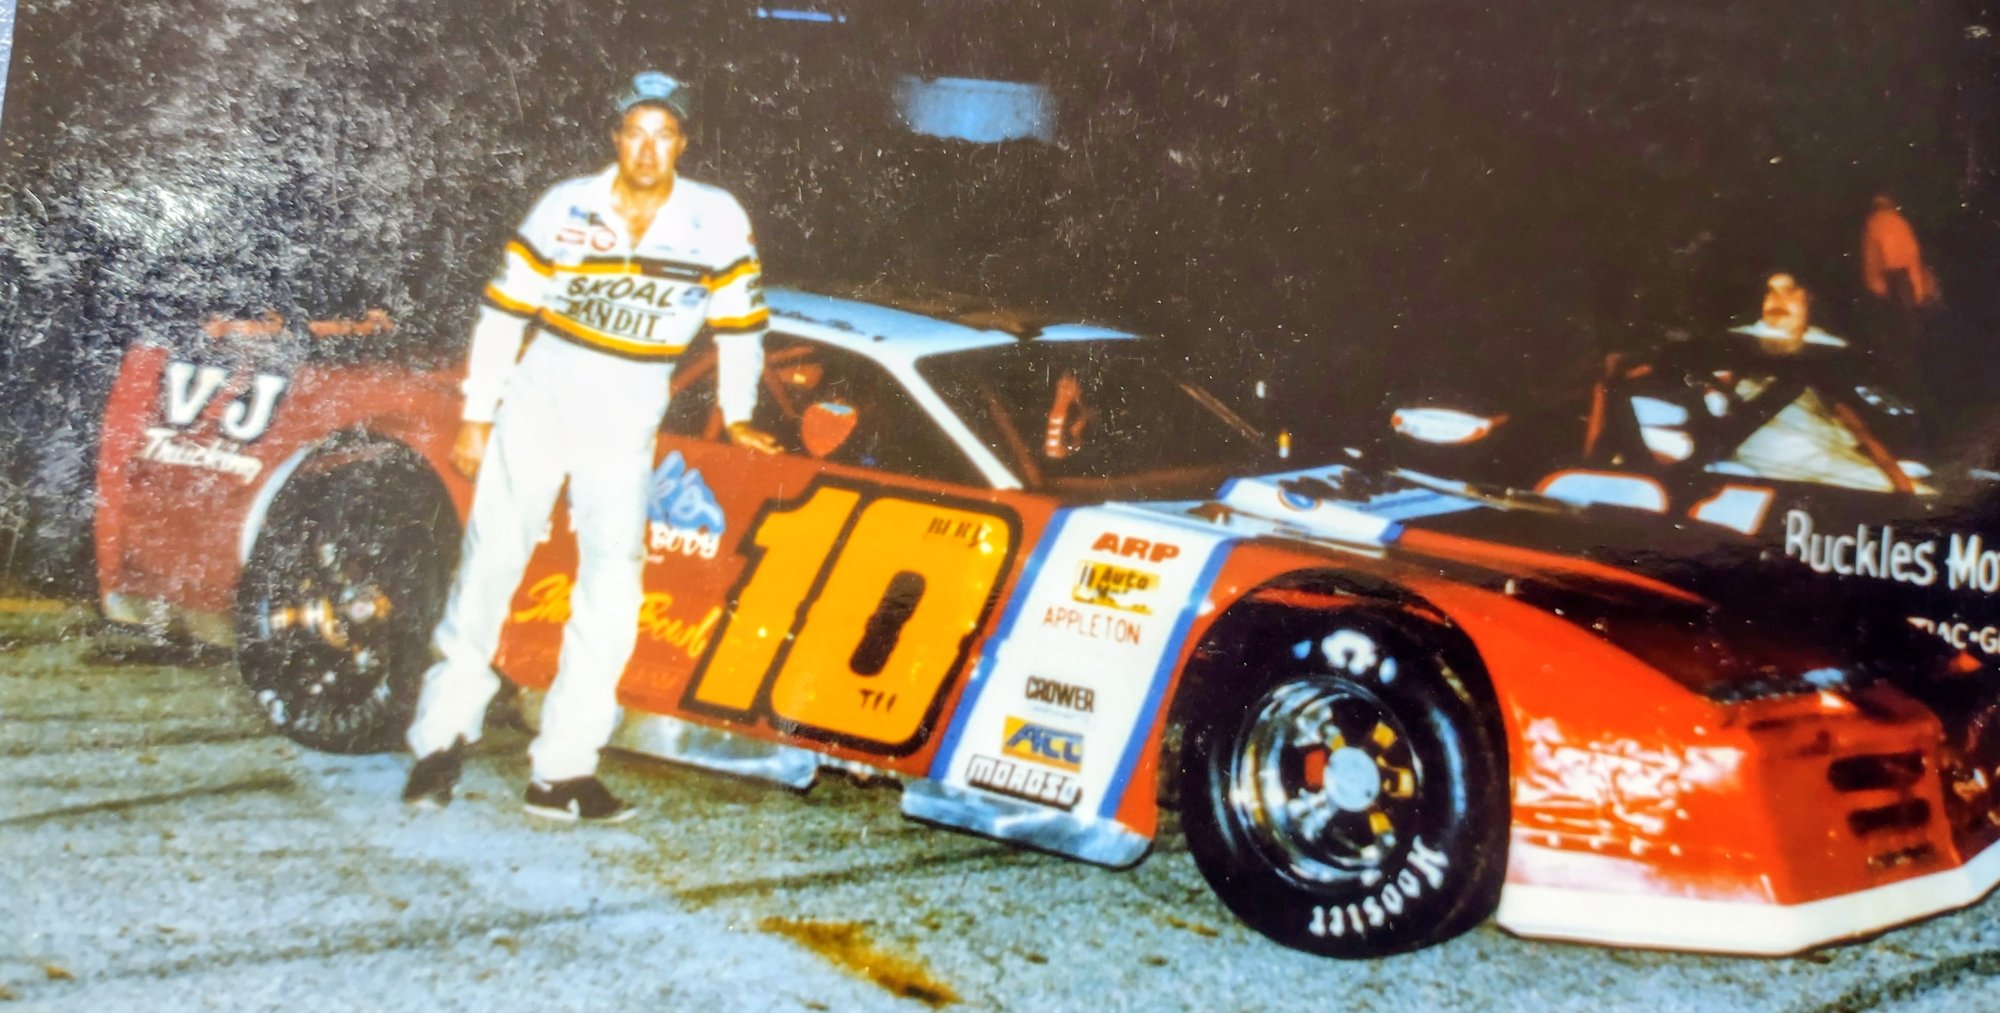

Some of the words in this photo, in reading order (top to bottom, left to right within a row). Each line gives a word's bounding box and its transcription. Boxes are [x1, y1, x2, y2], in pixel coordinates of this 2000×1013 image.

[567, 275, 674, 308] SKOAL
[567, 300, 661, 338] BANDIT
[1092, 532, 1180, 563] ARP
[1785, 509, 1936, 586] Buckles
[1944, 533, 2000, 593] Mo
[1099, 565, 1150, 591] Auto
[678, 474, 1024, 759] 10
[1043, 607, 1142, 645] APPLETON
[1025, 676, 1096, 713] CROWER
